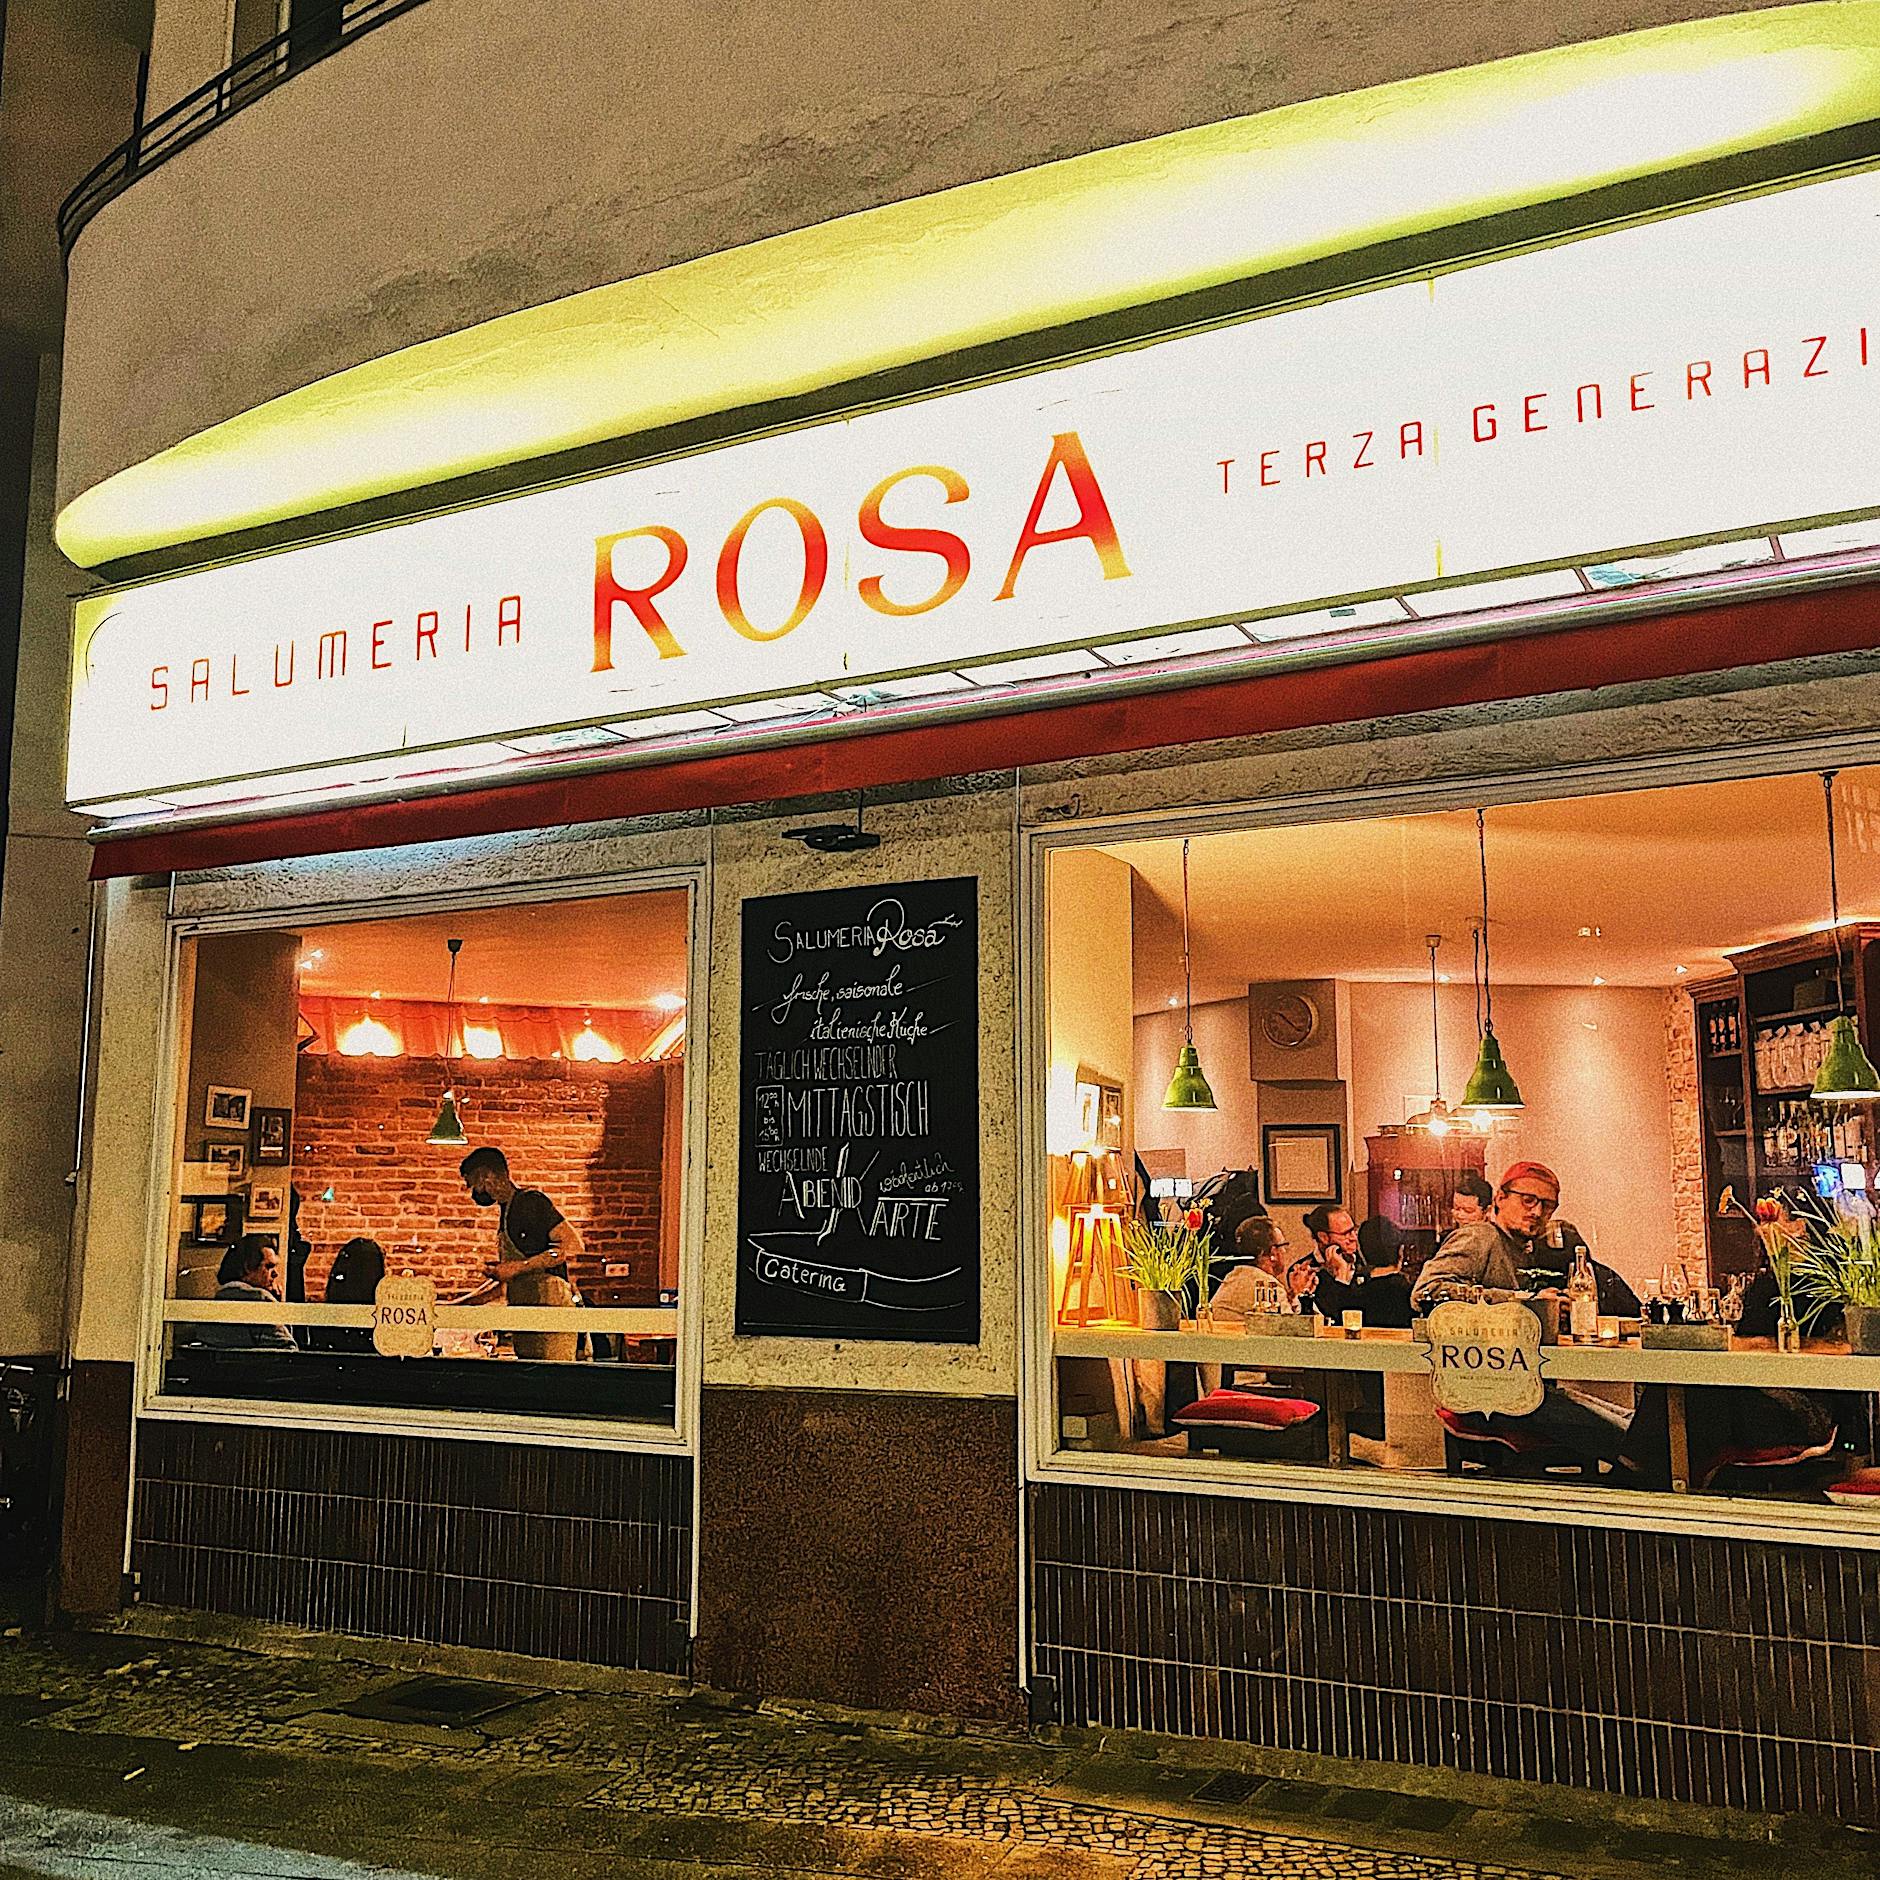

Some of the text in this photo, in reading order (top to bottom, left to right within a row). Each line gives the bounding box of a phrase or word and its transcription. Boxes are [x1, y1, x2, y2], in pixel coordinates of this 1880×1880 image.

[150, 327, 1869, 712] SALUMERIA ROSA TERZA GENERAZI
[867, 898, 955, 957] Rosa
[836, 964, 904, 999] saisonale
[810, 1007, 887, 1044] italienische
[814, 1044, 898, 1080] WECHSELNDER
[788, 1080, 929, 1138] MITTAGSTISCH
[759, 1147, 829, 1173] WECHSELNDE
[778, 1170, 862, 1220] ABEND
[381, 1307, 427, 1326] ROSA
[1441, 1345, 1530, 1372] ROSA
